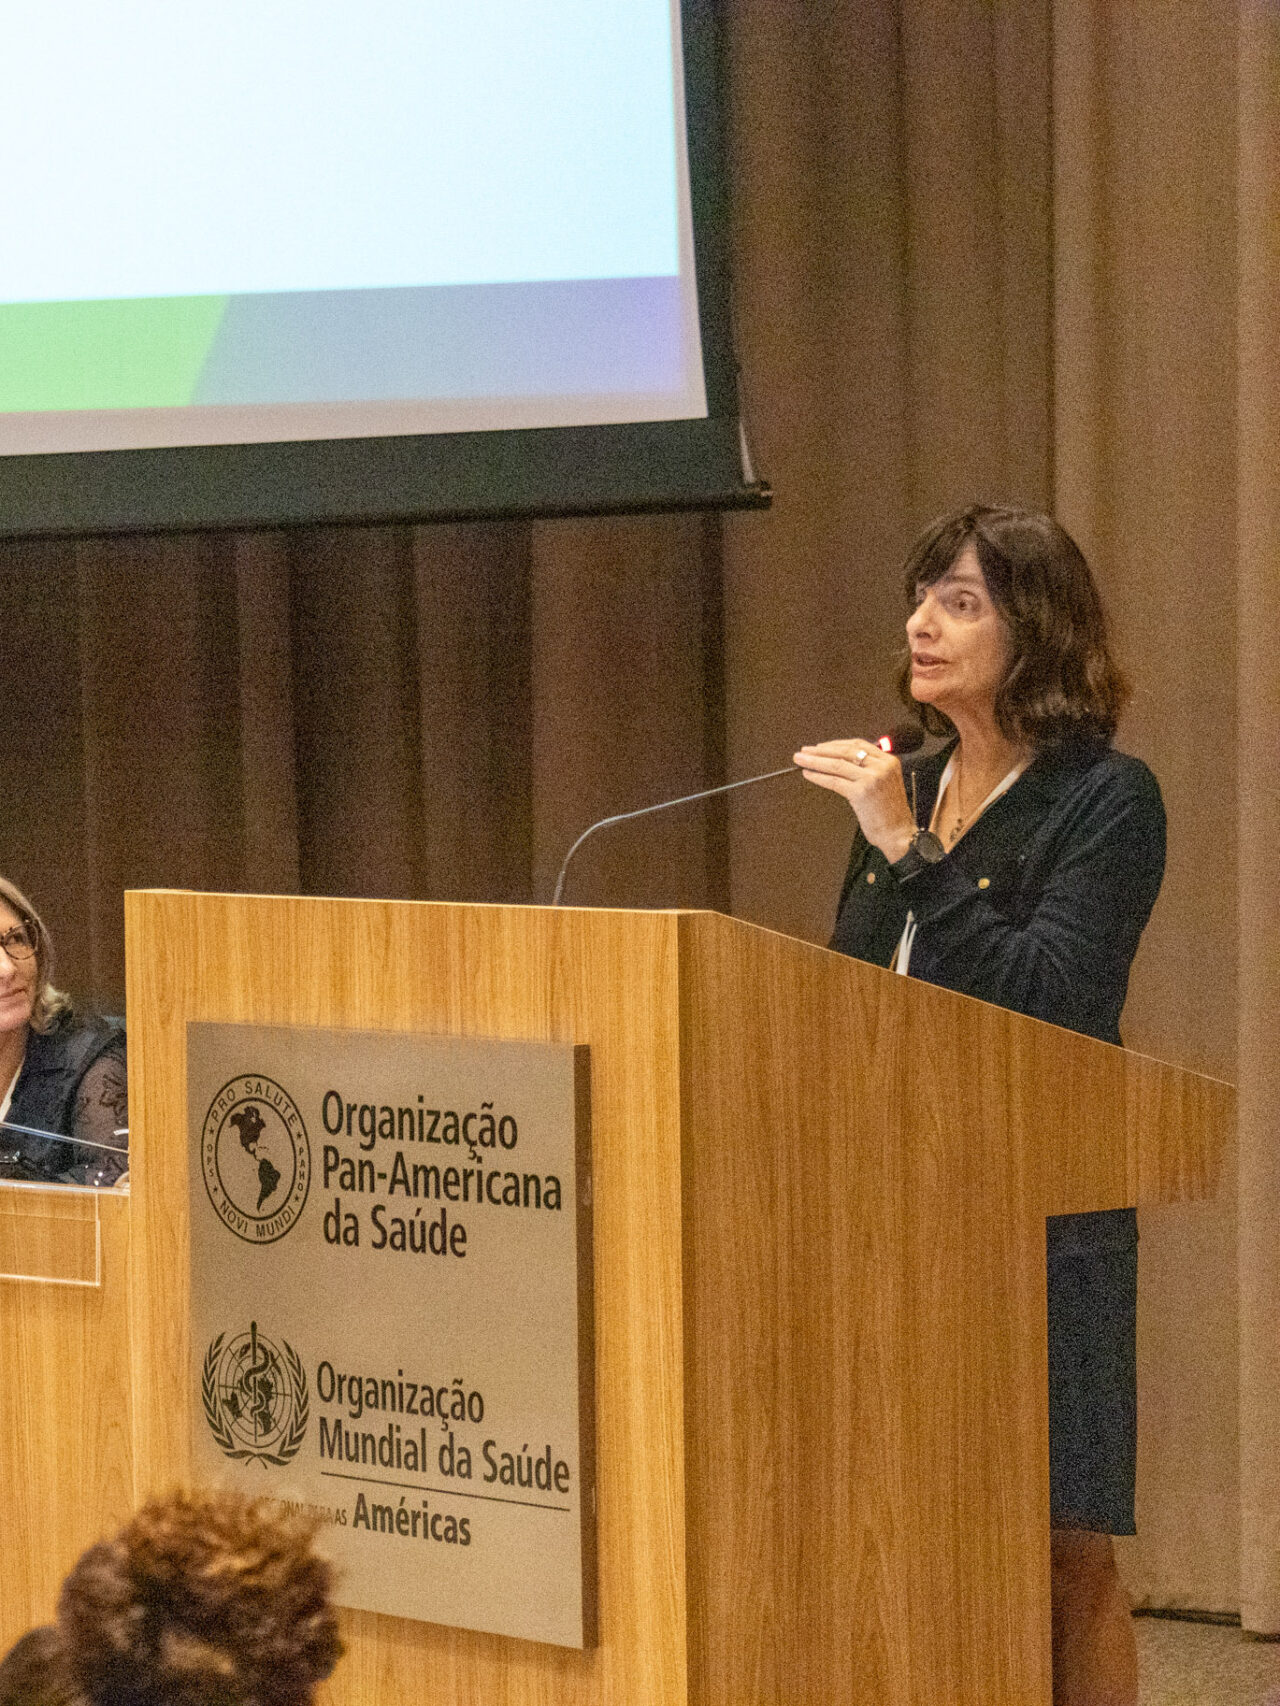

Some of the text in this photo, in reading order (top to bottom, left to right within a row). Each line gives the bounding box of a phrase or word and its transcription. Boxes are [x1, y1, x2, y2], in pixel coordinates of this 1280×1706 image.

[211, 1081, 298, 1127] PRO SALUTE
[322, 1090, 518, 1160] Organização
[207, 1143, 215, 1178] OPS
[298, 1146, 306, 1192] PAHO
[323, 1145, 562, 1211] Pan-Americana
[220, 1200, 295, 1238] NOVI MUNDI
[323, 1199, 467, 1257] da Saúde
[317, 1361, 484, 1430] Organização
[319, 1416, 570, 1493] Mundial da Saúde
[335, 1508, 347, 1526] AS
[353, 1493, 471, 1546] Américas
